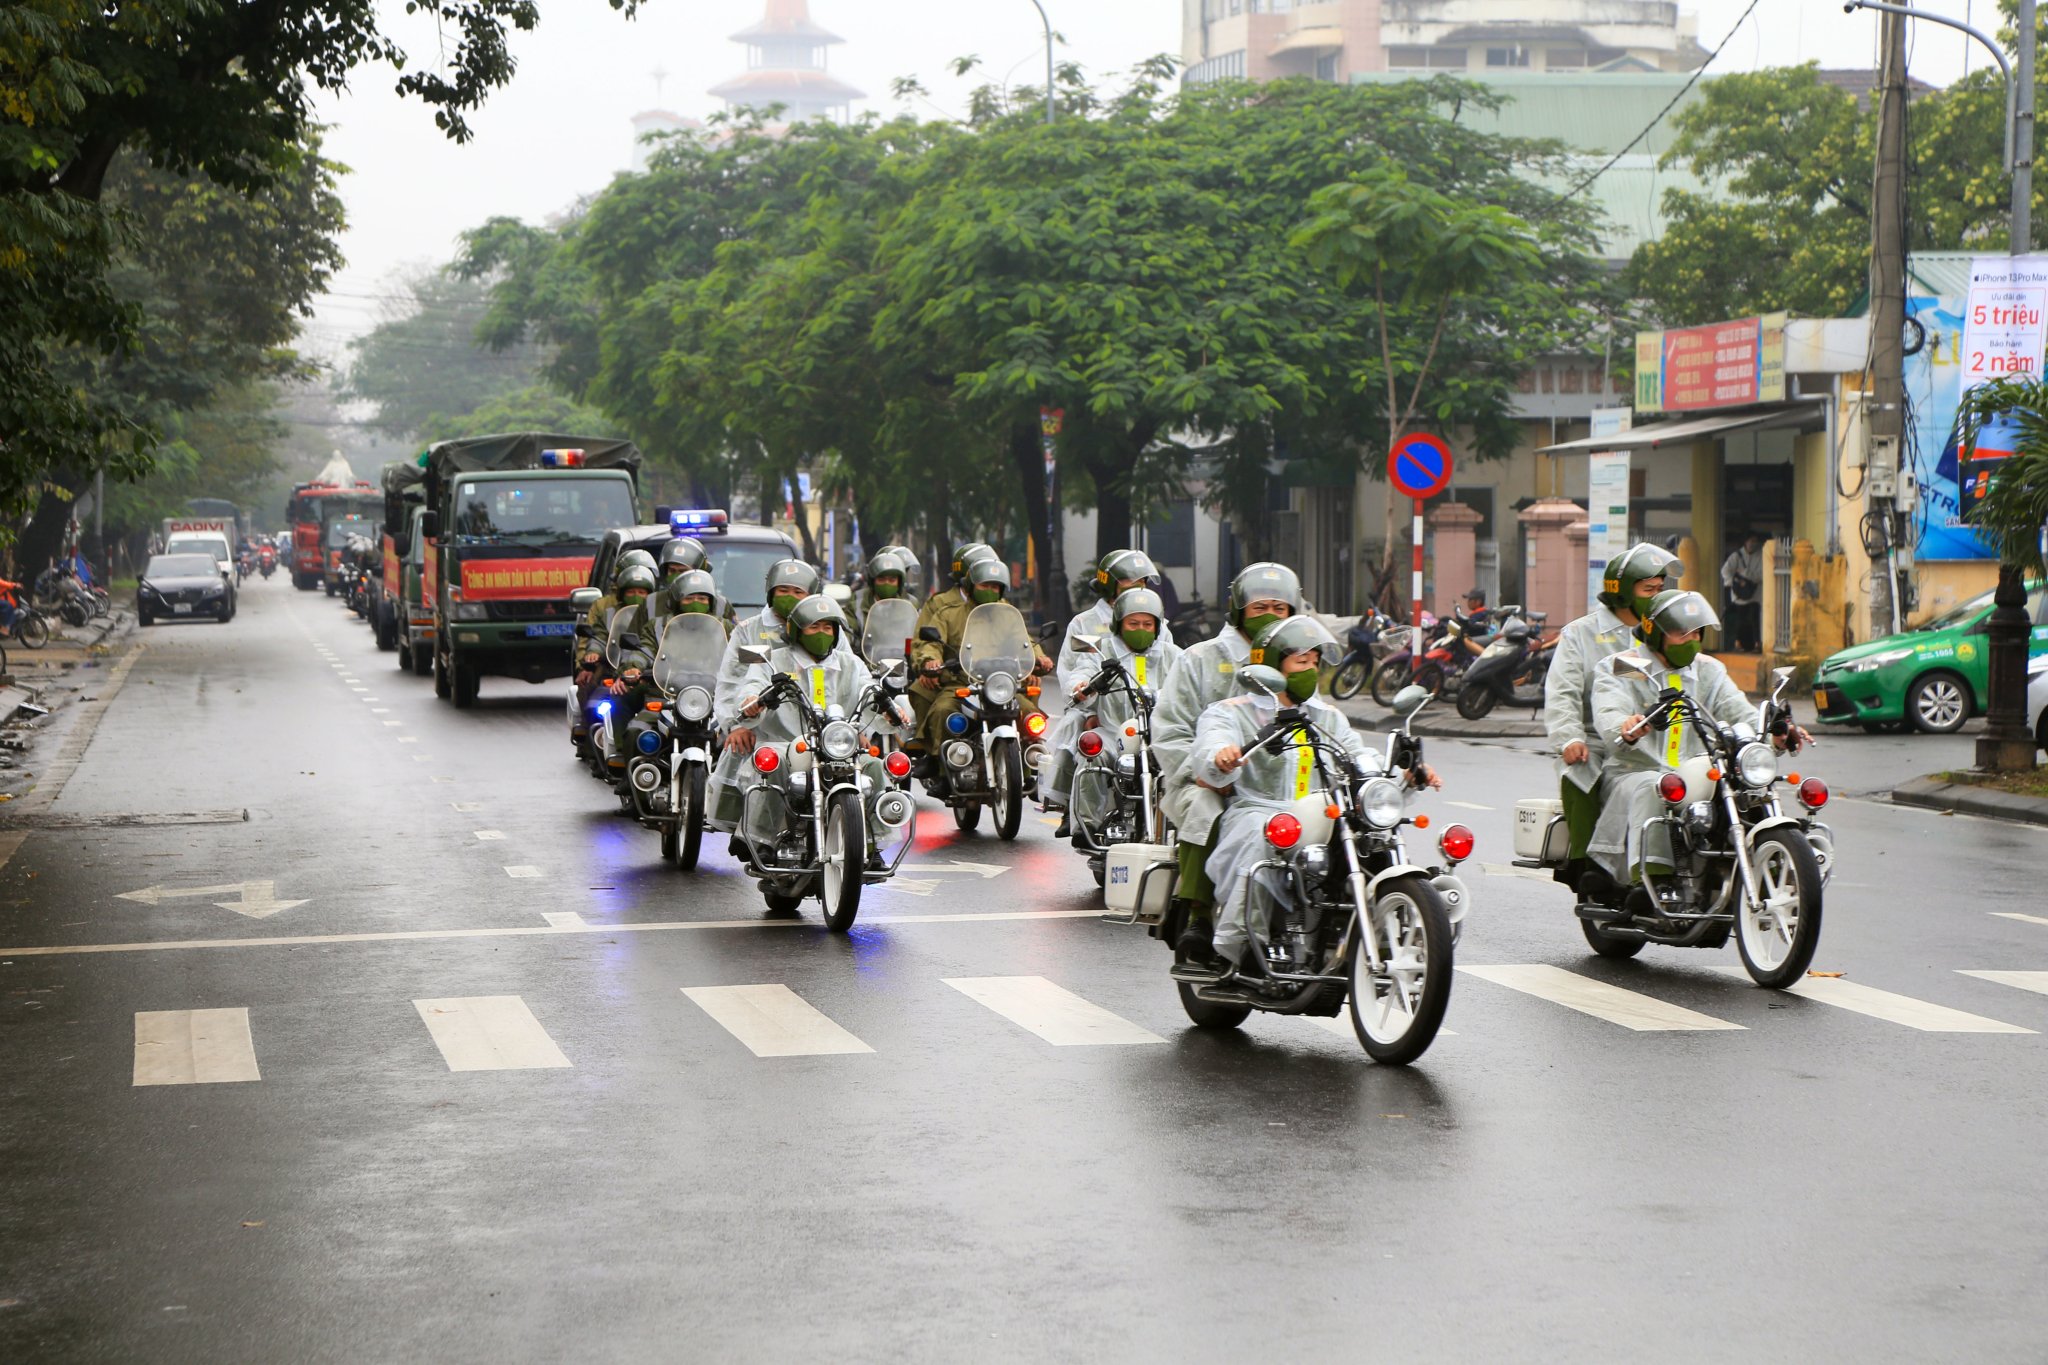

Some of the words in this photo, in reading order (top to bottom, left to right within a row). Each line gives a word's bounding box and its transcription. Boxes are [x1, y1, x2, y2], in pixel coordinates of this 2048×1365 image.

[1980, 273, 2007, 282] iPhone
[2032, 272, 2047, 281] Max
[1973, 305, 1987, 326] 5
[1993, 303, 2039, 331] triệu
[1972, 351, 1985, 372] 2
[1991, 351, 2034, 373] năm
[170, 522, 224, 532] CADIVI
